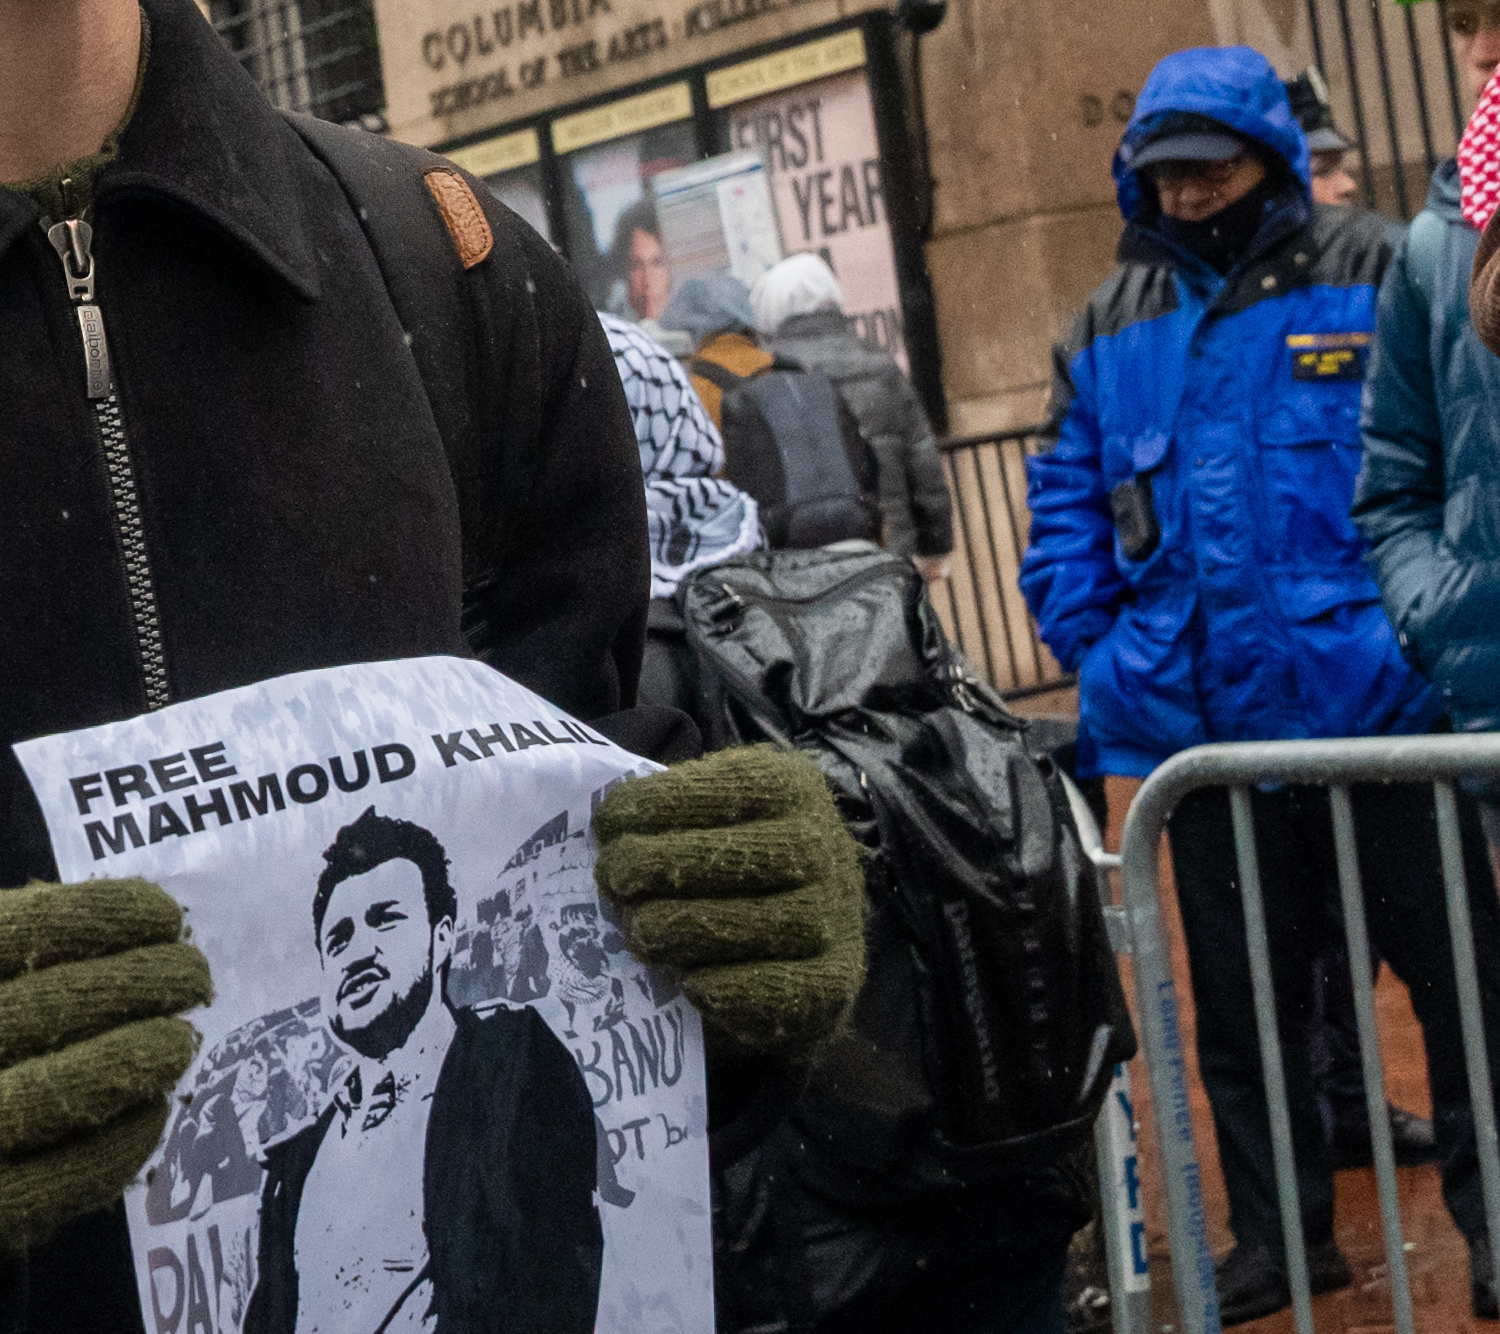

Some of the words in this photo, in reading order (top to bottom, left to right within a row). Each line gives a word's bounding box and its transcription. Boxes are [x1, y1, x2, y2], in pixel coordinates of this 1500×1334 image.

[429, 66, 516, 118] SCHOOL
[519, 56, 547, 89] OF
[556, 40, 601, 78] THE
[606, 18, 668, 64] ARTS
[791, 159, 884, 243] YEAR
[69, 741, 238, 815] FREE
[83, 743, 417, 861] MAHMOUD
[431, 720, 610, 768] KHALIL
